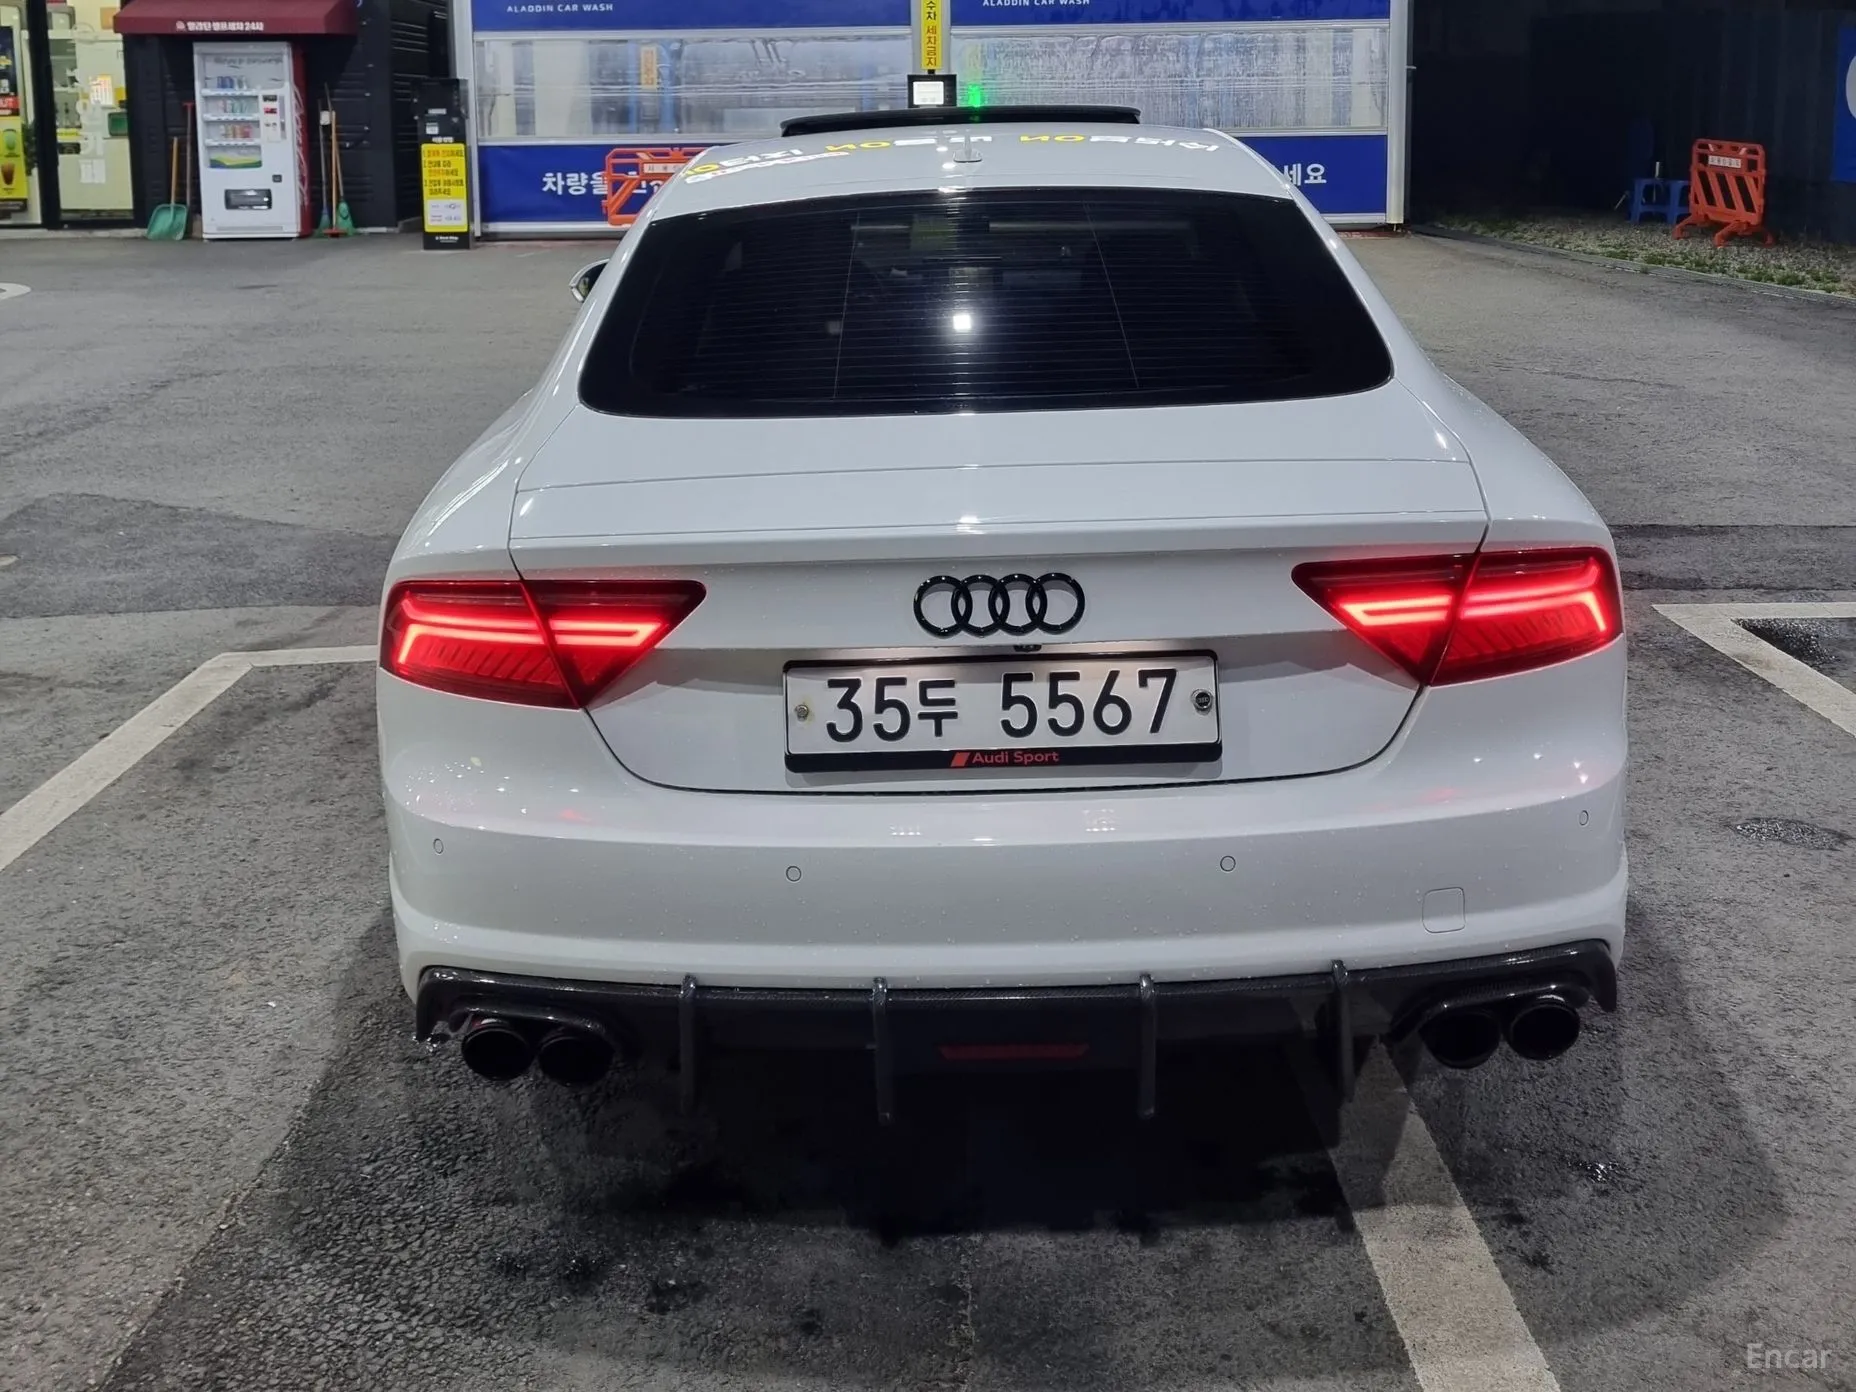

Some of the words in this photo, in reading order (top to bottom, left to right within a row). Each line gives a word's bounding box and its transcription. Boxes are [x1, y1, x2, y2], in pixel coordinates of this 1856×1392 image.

[507, 5, 554, 13] ALADDIN
[557, 4, 578, 12] CAR
[582, 3, 613, 12] WASH
[542, 172, 608, 195] 차량을
[826, 676, 959, 743] 35두
[1000, 668, 1178, 738] 5567
[972, 751, 1009, 764] Audi
[1014, 750, 1060, 765] Sport
